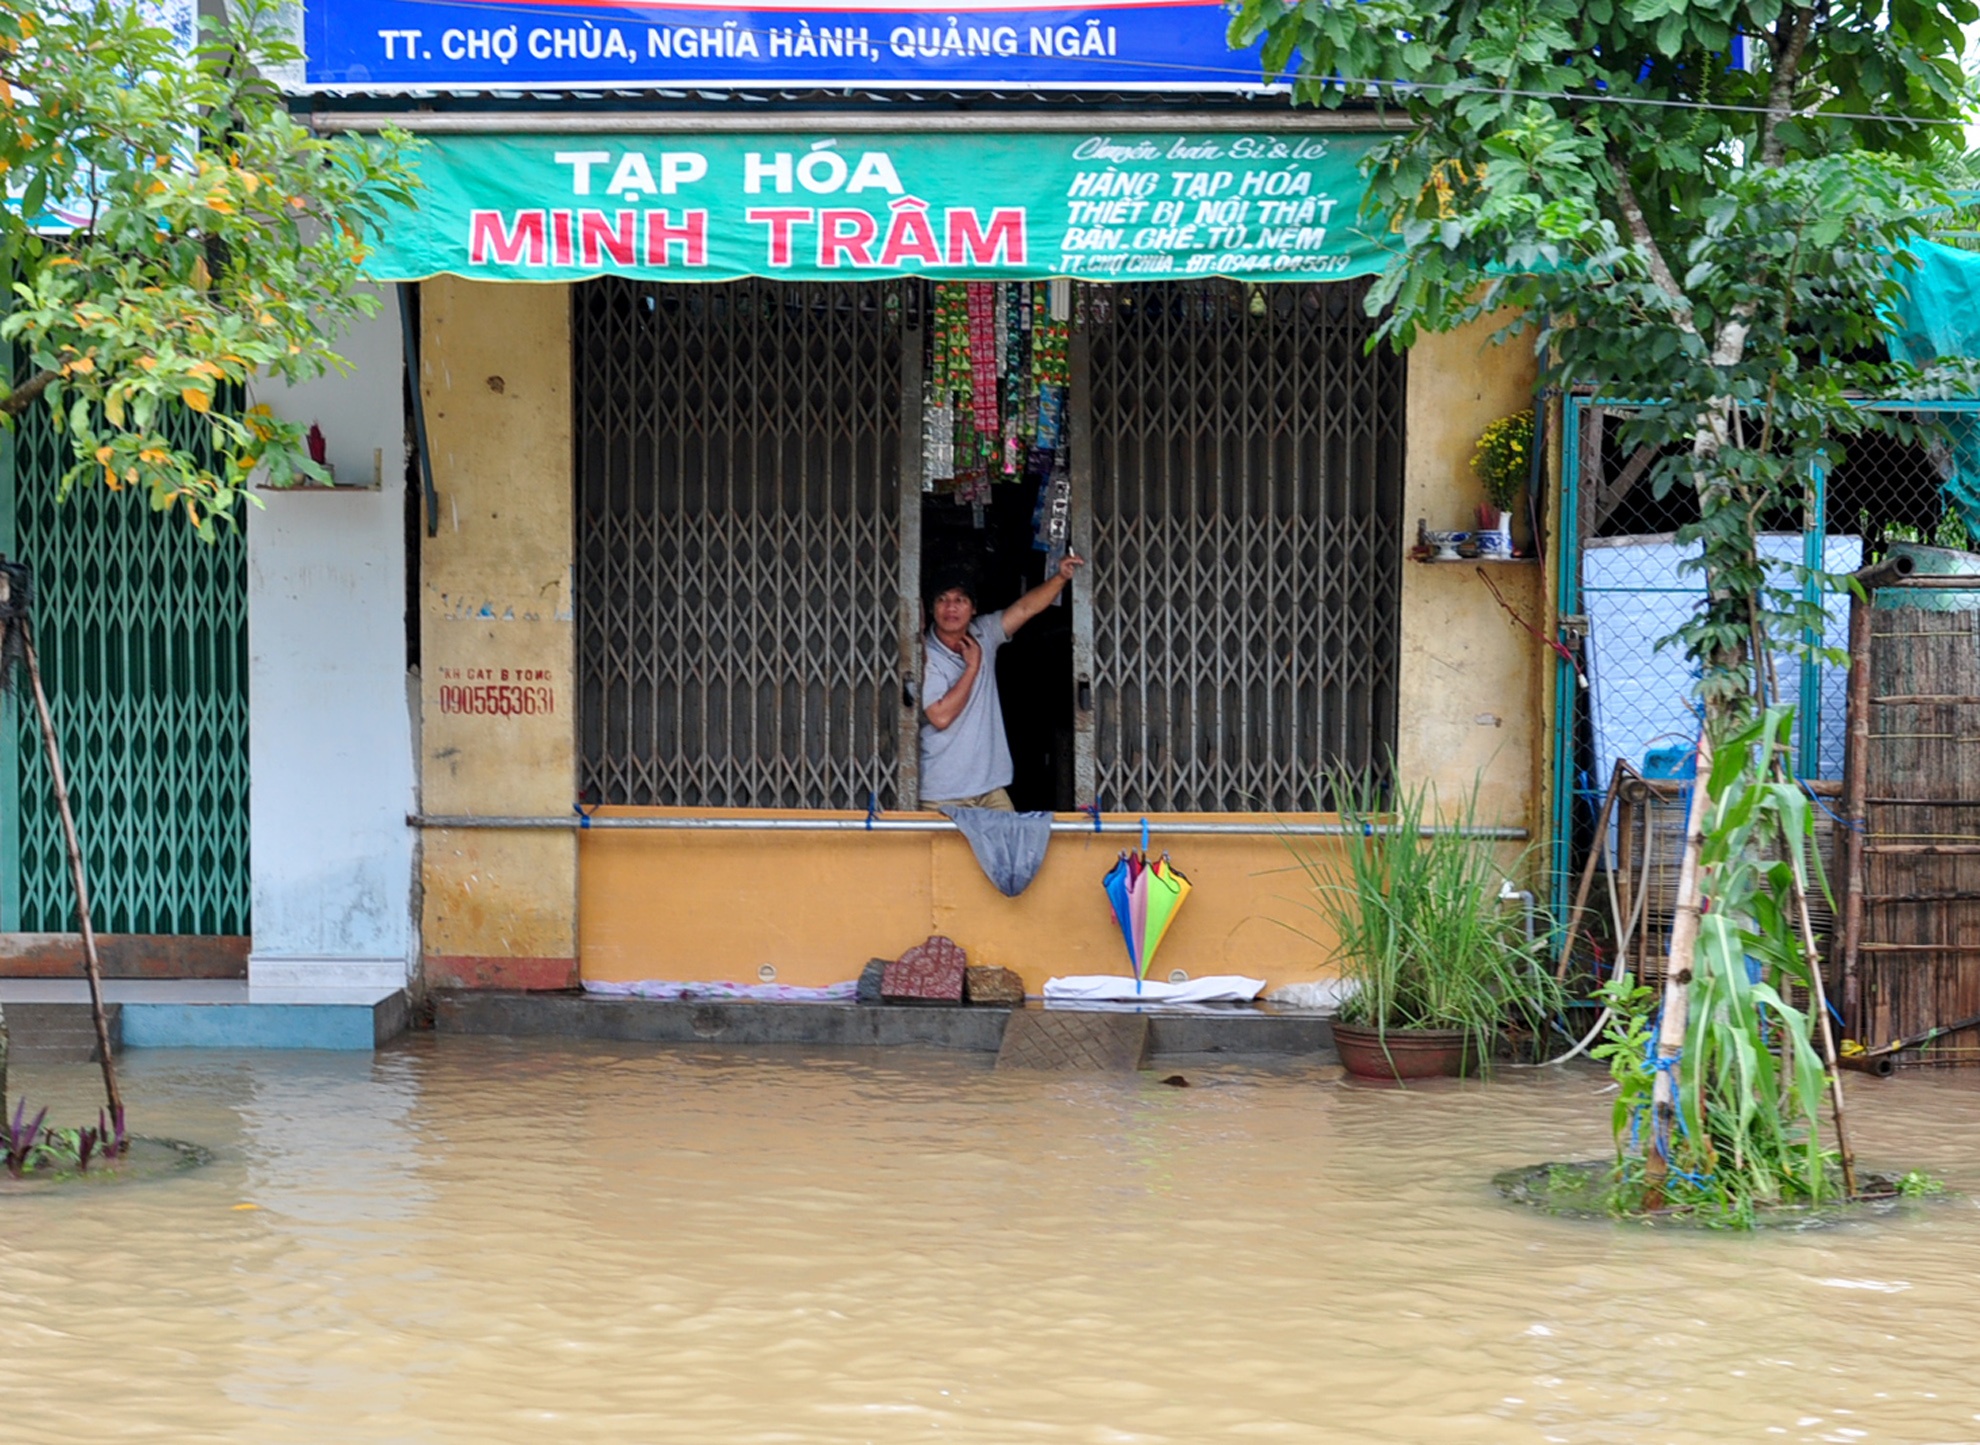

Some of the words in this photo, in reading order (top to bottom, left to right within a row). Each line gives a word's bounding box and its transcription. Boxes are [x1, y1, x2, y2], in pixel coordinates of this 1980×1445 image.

[378, 30, 431, 59] TT.
[441, 25, 518, 64] CHỢ
[528, 20, 637, 63] CHÙA,
[648, 20, 759, 57] NGHĨA
[769, 20, 880, 62] HÀNH,
[890, 17, 1017, 57] QUẢNG
[1030, 19, 1116, 56] NGÃI
[1166, 136, 1226, 160] bán
[554, 151, 708, 201] TẠP
[744, 139, 904, 194] HÓA
[1067, 166, 1159, 197] HÀNG
[1171, 171, 1233, 199] TẠP
[1238, 164, 1314, 197] HÓA
[1067, 196, 1150, 225] THIẾT
[1151, 200, 1185, 228] BỊ
[1194, 195, 1251, 227] NỘI
[1257, 193, 1338, 225] THẤT
[468, 207, 709, 268] MINH
[745, 194, 1027, 268] TRÂM
[440, 685, 554, 716] 0905553631
